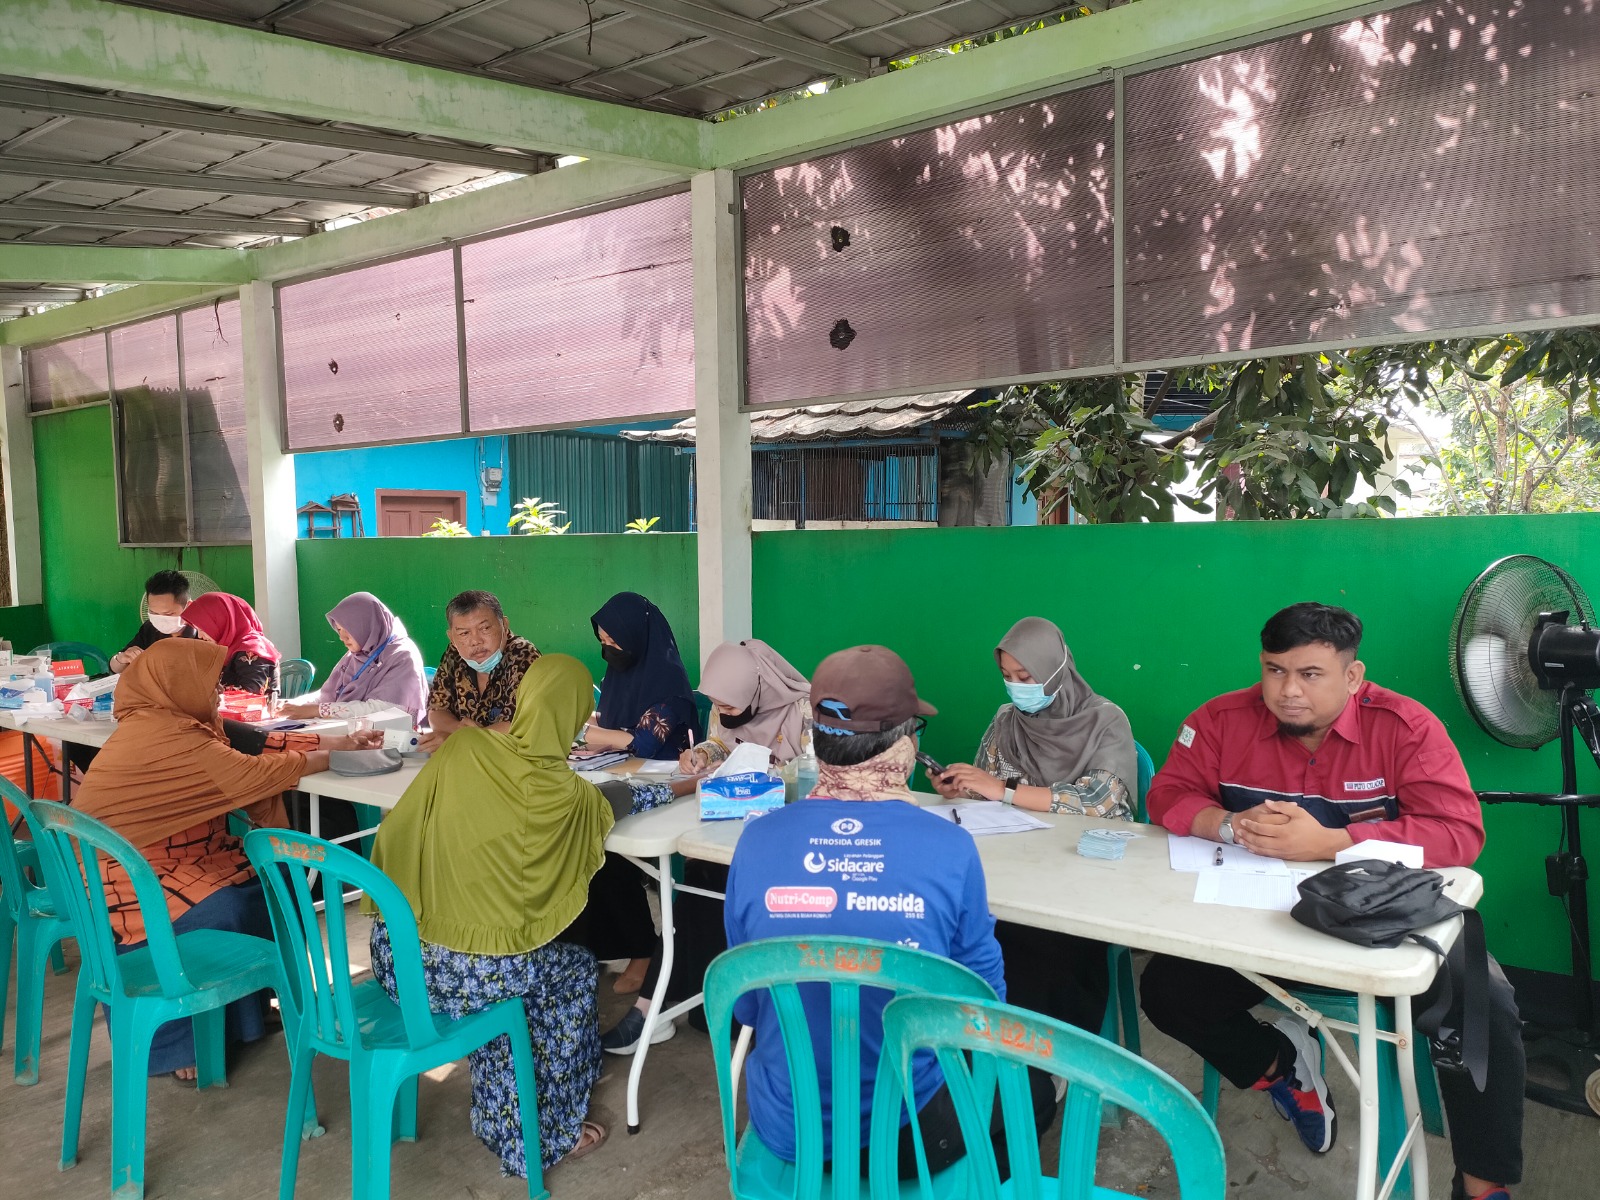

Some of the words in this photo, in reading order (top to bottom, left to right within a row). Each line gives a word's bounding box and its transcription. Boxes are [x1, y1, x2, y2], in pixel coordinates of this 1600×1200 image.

[809, 837, 852, 846] PETROSIDA
[854, 838, 882, 847] GRESIK
[827, 858, 885, 873] Sidacare
[769, 892, 833, 908] Nutri-Comp
[846, 892, 925, 913] Fenosida
